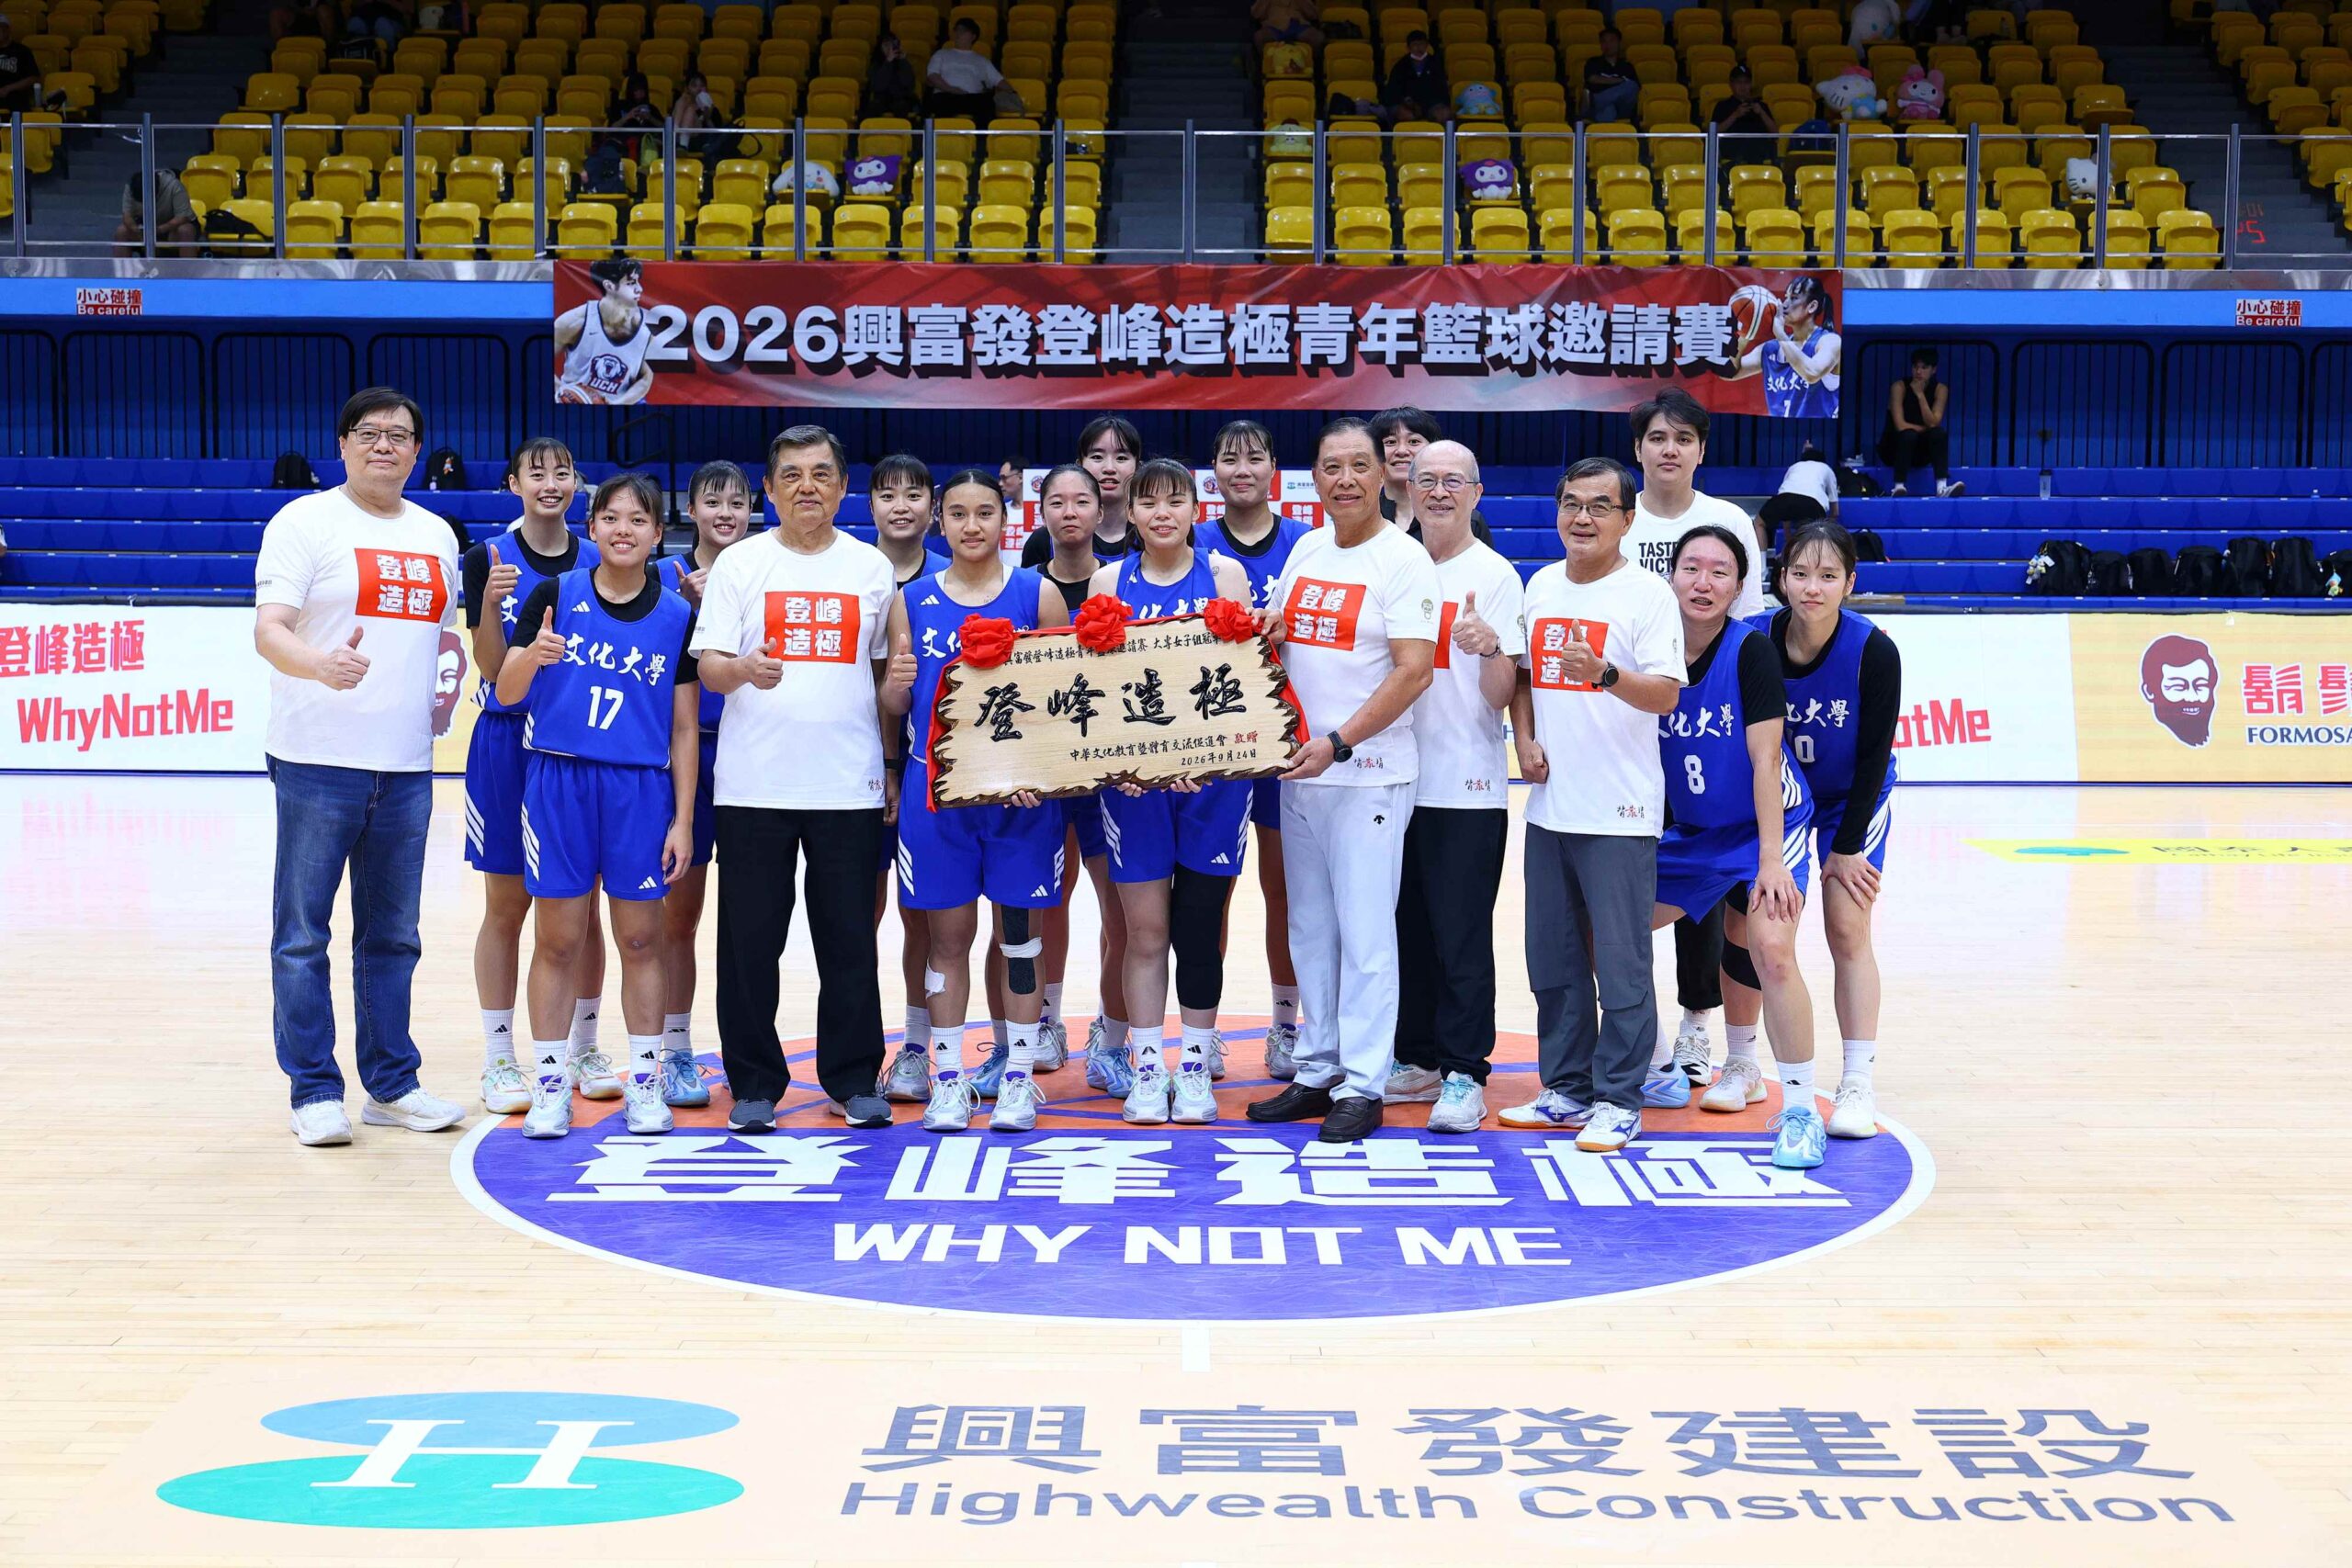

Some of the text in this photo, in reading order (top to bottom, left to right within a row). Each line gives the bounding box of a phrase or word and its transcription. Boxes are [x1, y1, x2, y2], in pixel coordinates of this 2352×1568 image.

[77, 288, 142, 304] 小心碰撞
[77, 304, 142, 315] Be careful
[2236, 299, 2301, 315] 小心碰撞
[644, 302, 1733, 367] 2026興富發登峰造極青年籃球邀請賽
[2236, 315, 2301, 326] Be careful
[376, 554, 432, 584] 登峰
[377, 583, 434, 616] 造極
[784, 596, 842, 625] 登峰
[1297, 583, 1348, 613] 登峰
[783, 628, 842, 658] 造極
[1293, 613, 1339, 643] 造極
[0, 620, 145, 678] 登峰造極
[562, 632, 667, 687] 文化大學
[17, 687, 233, 752] WhyNotMe
[587, 685, 625, 730] 17
[974, 662, 1247, 743] 登峰造極
[1181, 748, 1257, 766] 2026年9月24日
[1684, 755, 1706, 795] 8
[546, 1135, 1852, 1205] 登峰造極
[833, 1223, 1573, 1266] WHY NOT ME
[860, 1404, 2196, 1480] 興富發建設
[840, 1482, 2236, 1526] Highwealth Construction
